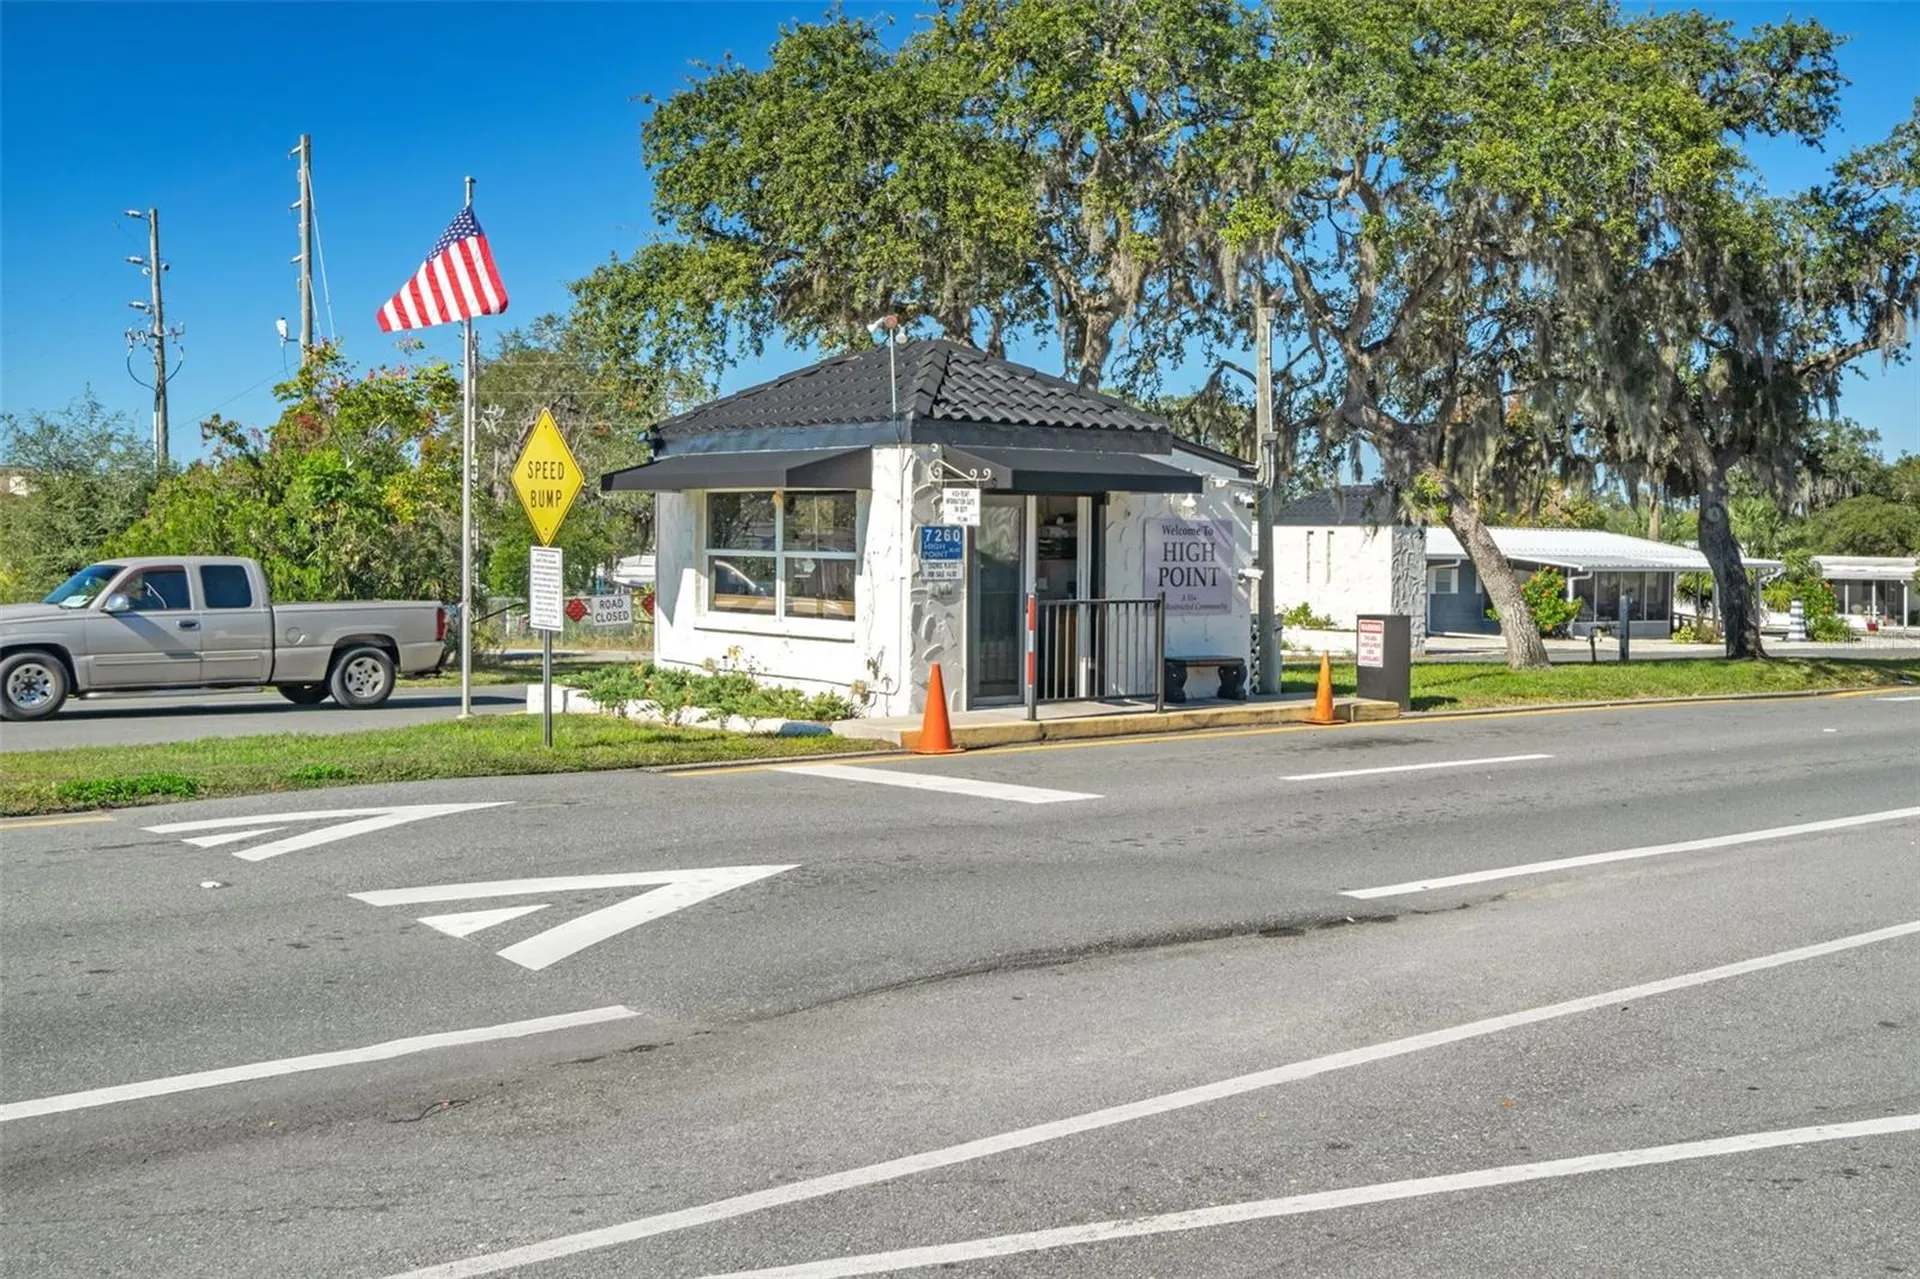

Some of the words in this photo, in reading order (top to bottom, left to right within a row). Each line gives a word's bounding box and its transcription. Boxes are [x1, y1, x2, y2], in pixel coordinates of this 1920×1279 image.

[527, 461, 565, 480] SPEED
[530, 489, 562, 508] BUMP
[924, 529, 961, 542] 7260
[1162, 524, 1201, 536] Welcome
[1203, 525, 1214, 536] To
[1162, 542, 1216, 562] HIGH
[1158, 567, 1221, 587] POINT
[599, 598, 624, 610] ROAD
[595, 611, 630, 623] CLOSED
